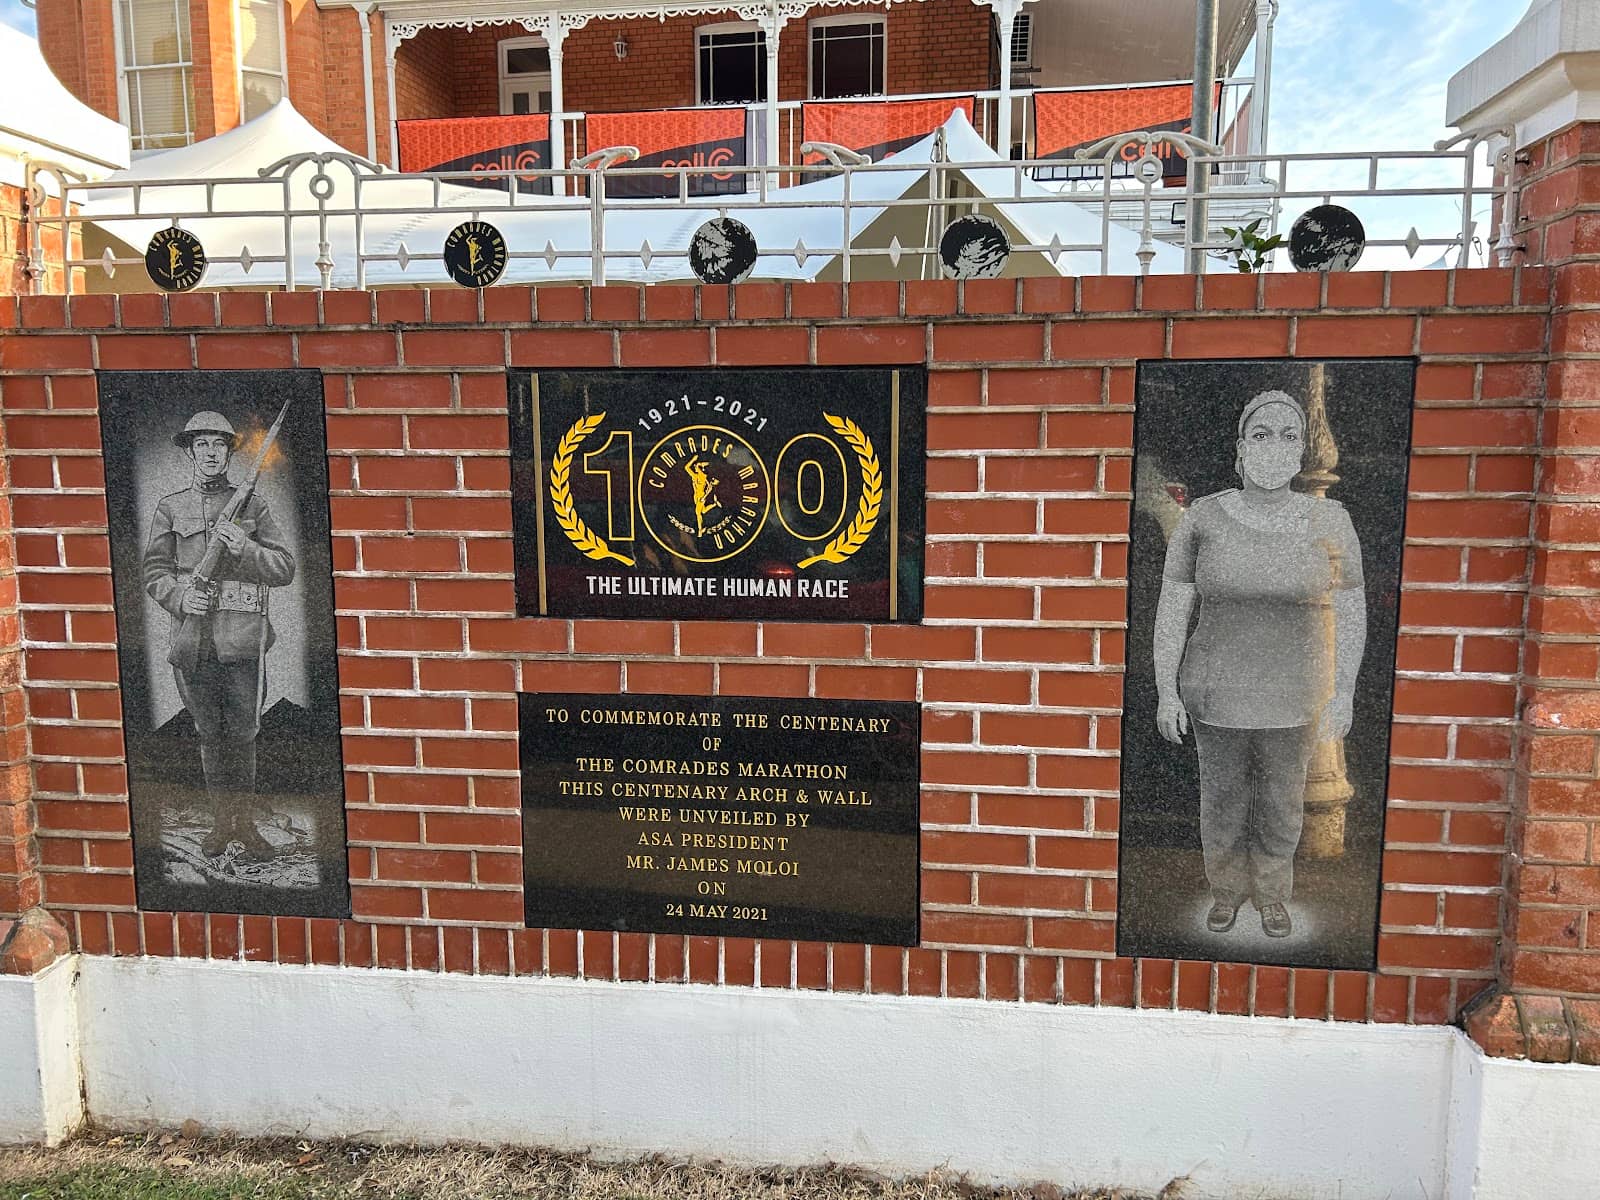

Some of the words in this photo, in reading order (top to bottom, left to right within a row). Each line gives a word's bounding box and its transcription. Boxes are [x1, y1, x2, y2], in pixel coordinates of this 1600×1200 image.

[648, 435, 734, 488] COMRADES
[714, 464, 759, 550] MARATHON
[586, 575, 621, 595] THE
[628, 577, 716, 597] ULTIMATE
[723, 579, 791, 598] HUMAN
[798, 580, 849, 599] RACE
[545, 708, 569, 723] TO
[580, 709, 721, 727] COMMEMORATE
[732, 713, 769, 729] THE
[780, 714, 891, 733] CENTENARY
[702, 736, 722, 752] OF
[576, 757, 614, 773] THE
[622, 758, 730, 776] COMRADES
[738, 762, 848, 780] MARATHON
[559, 781, 604, 797] THIS
[611, 782, 729, 800] CENTENARY
[735, 786, 788, 803] ARCH
[795, 789, 809, 804] &
[816, 790, 872, 806] WALL
[618, 806, 672, 822] WERE
[678, 808, 777, 826] UNVEILED
[785, 812, 810, 828] BY
[637, 831, 675, 847] ASA
[680, 832, 789, 851] PRESIDENT
[626, 854, 660, 870] MR.
[666, 856, 729, 873] JAMES
[736, 859, 800, 877] MOLOI
[697, 880, 727, 896] ON
[666, 903, 684, 917] 24
[689, 903, 729, 919] MAY
[732, 906, 768, 921] 2021
